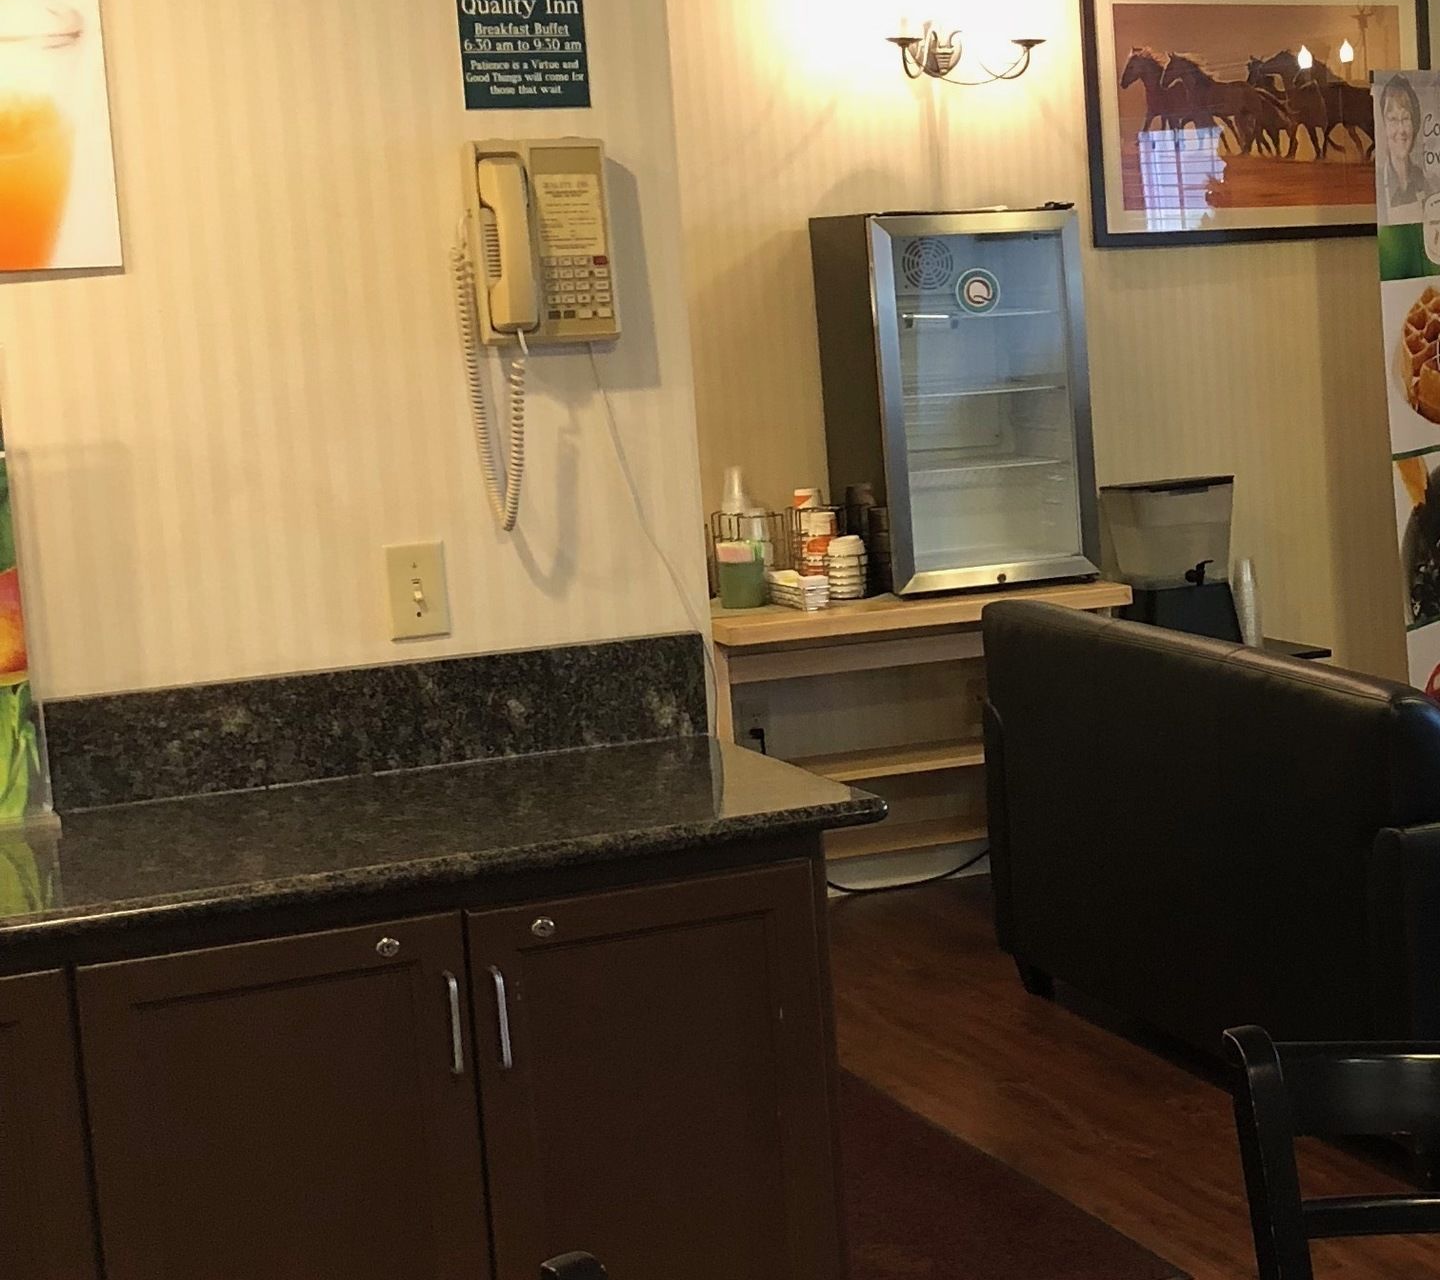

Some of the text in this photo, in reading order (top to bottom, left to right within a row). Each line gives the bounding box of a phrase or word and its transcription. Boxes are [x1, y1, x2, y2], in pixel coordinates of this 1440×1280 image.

[475, 22, 569, 35] Breakfast Buffet
[464, 39, 491, 51] 6:30
[496, 41, 513, 51] am
[517, 40, 529, 50] to
[565, 41, 581, 50] am
[470, 60, 510, 70] Patience
[512, 60, 520, 69] is
[531, 60, 559, 69] Virtue
[563, 60, 579, 68] and
[466, 73, 490, 82] Good
[492, 72, 522, 83] Things
[525, 72, 542, 81] will
[572, 72, 584, 81] for
[490, 85, 515, 94] those
[518, 85, 537, 94] that
[966, 279, 992, 305] Q
